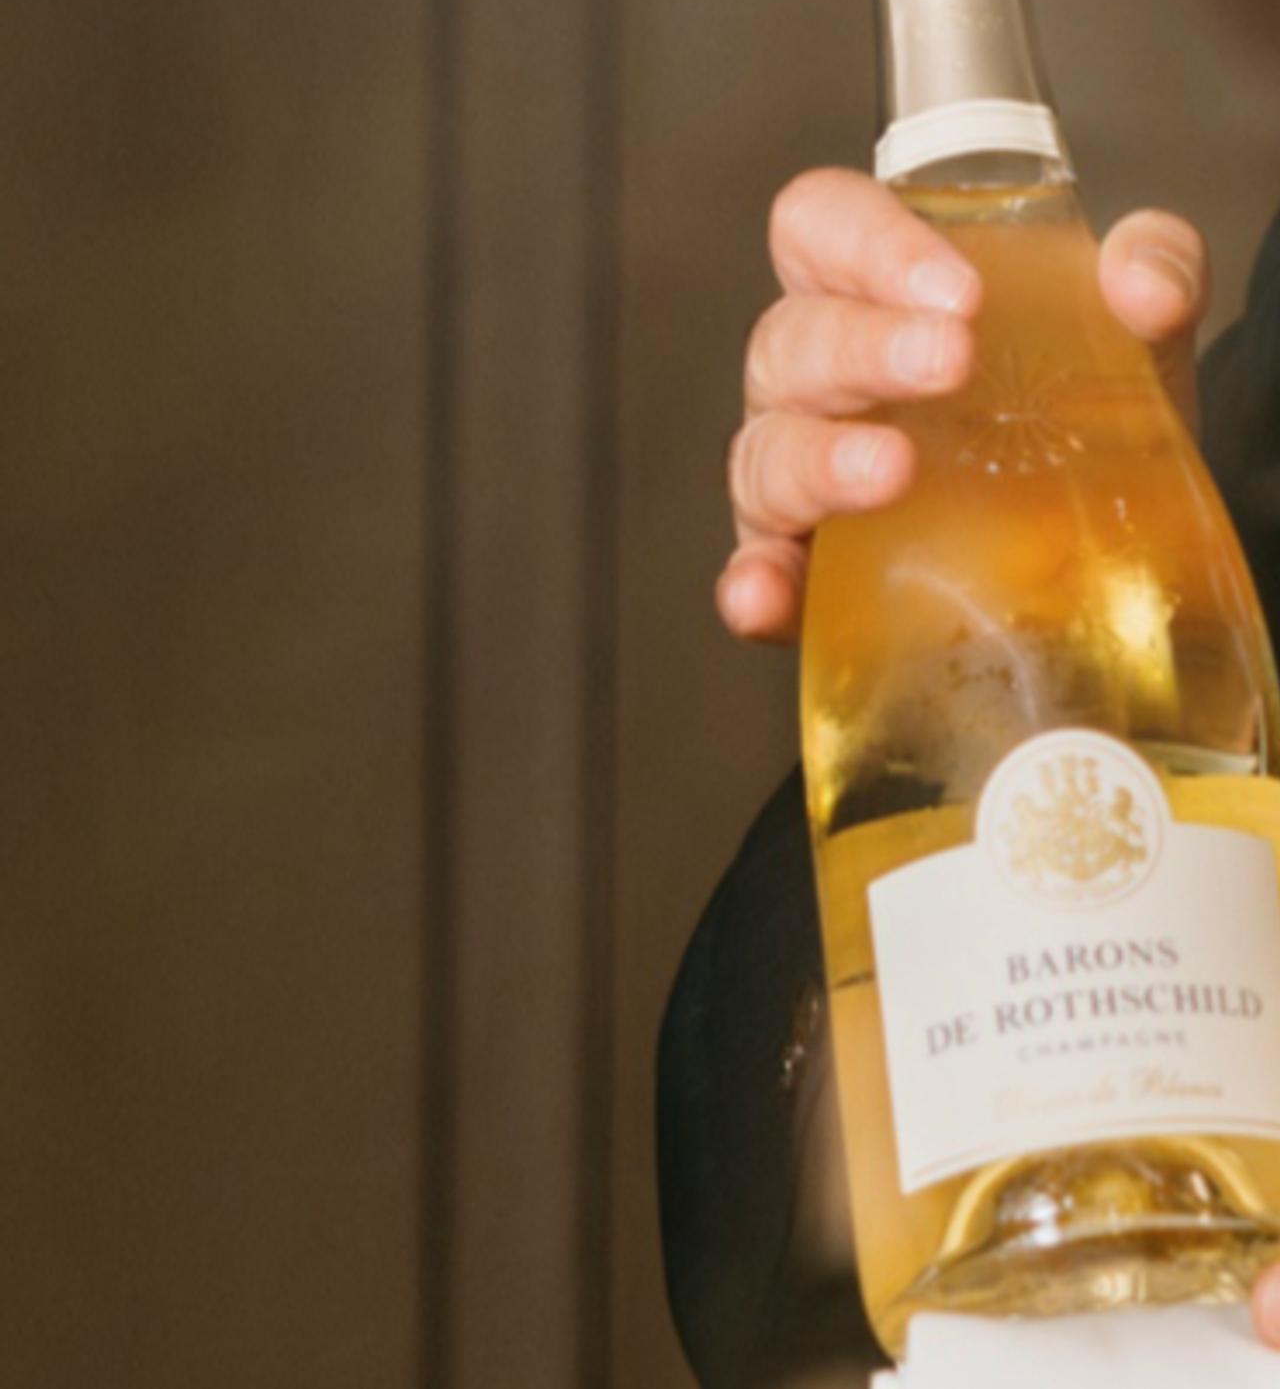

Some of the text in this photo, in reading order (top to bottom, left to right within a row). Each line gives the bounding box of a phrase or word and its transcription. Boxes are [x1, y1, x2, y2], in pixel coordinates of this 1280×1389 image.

[1007, 938, 1179, 984] BARONS
[926, 984, 1264, 1057] DE ROTHSCHILD
[1017, 1029, 1189, 1064] CHAMPAGNE
